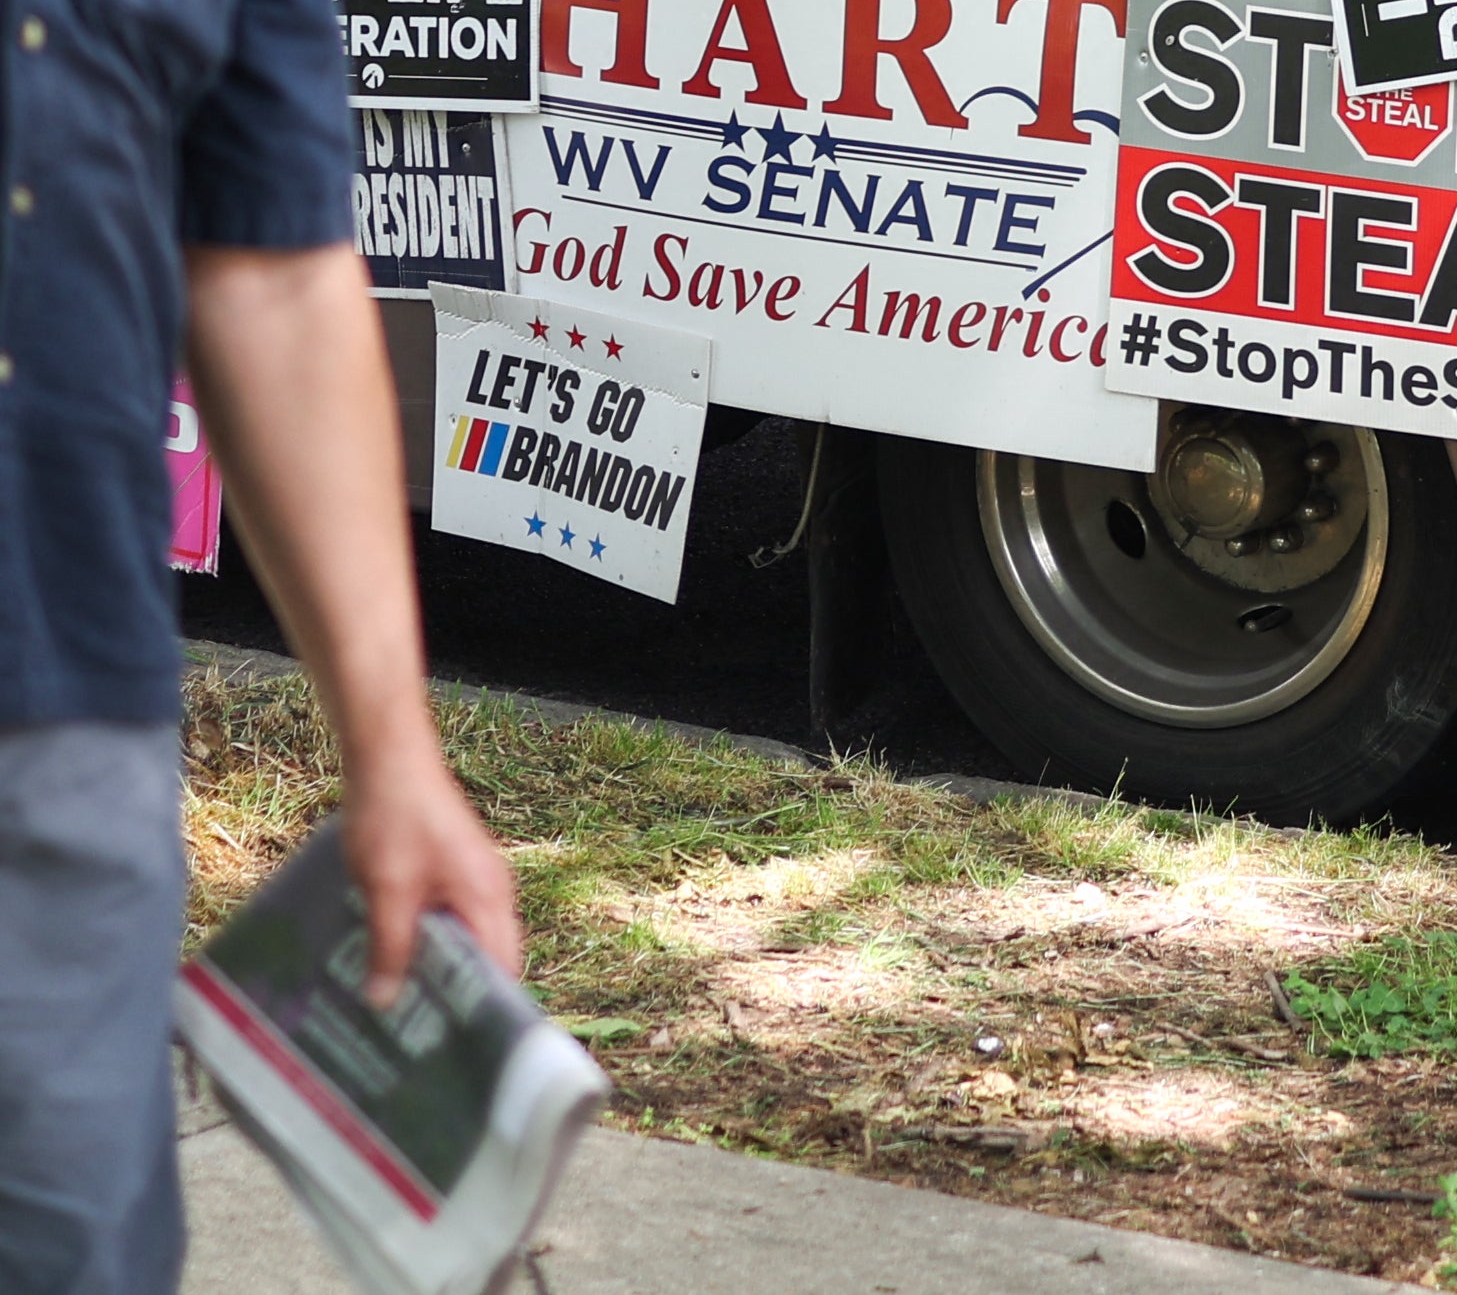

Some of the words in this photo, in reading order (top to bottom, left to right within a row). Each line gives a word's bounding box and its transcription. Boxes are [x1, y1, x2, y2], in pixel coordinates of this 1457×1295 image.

[1344, 95, 1436, 130] STEAL
[356, 174, 494, 260] RESIDENT
[542, 125, 671, 202] WV
[703, 156, 1056, 256] SENATE
[511, 208, 625, 291] God
[644, 234, 802, 323] Save
[466, 348, 580, 424] LET'S
[587, 377, 646, 442] GO
[505, 422, 685, 531] BRANDON
